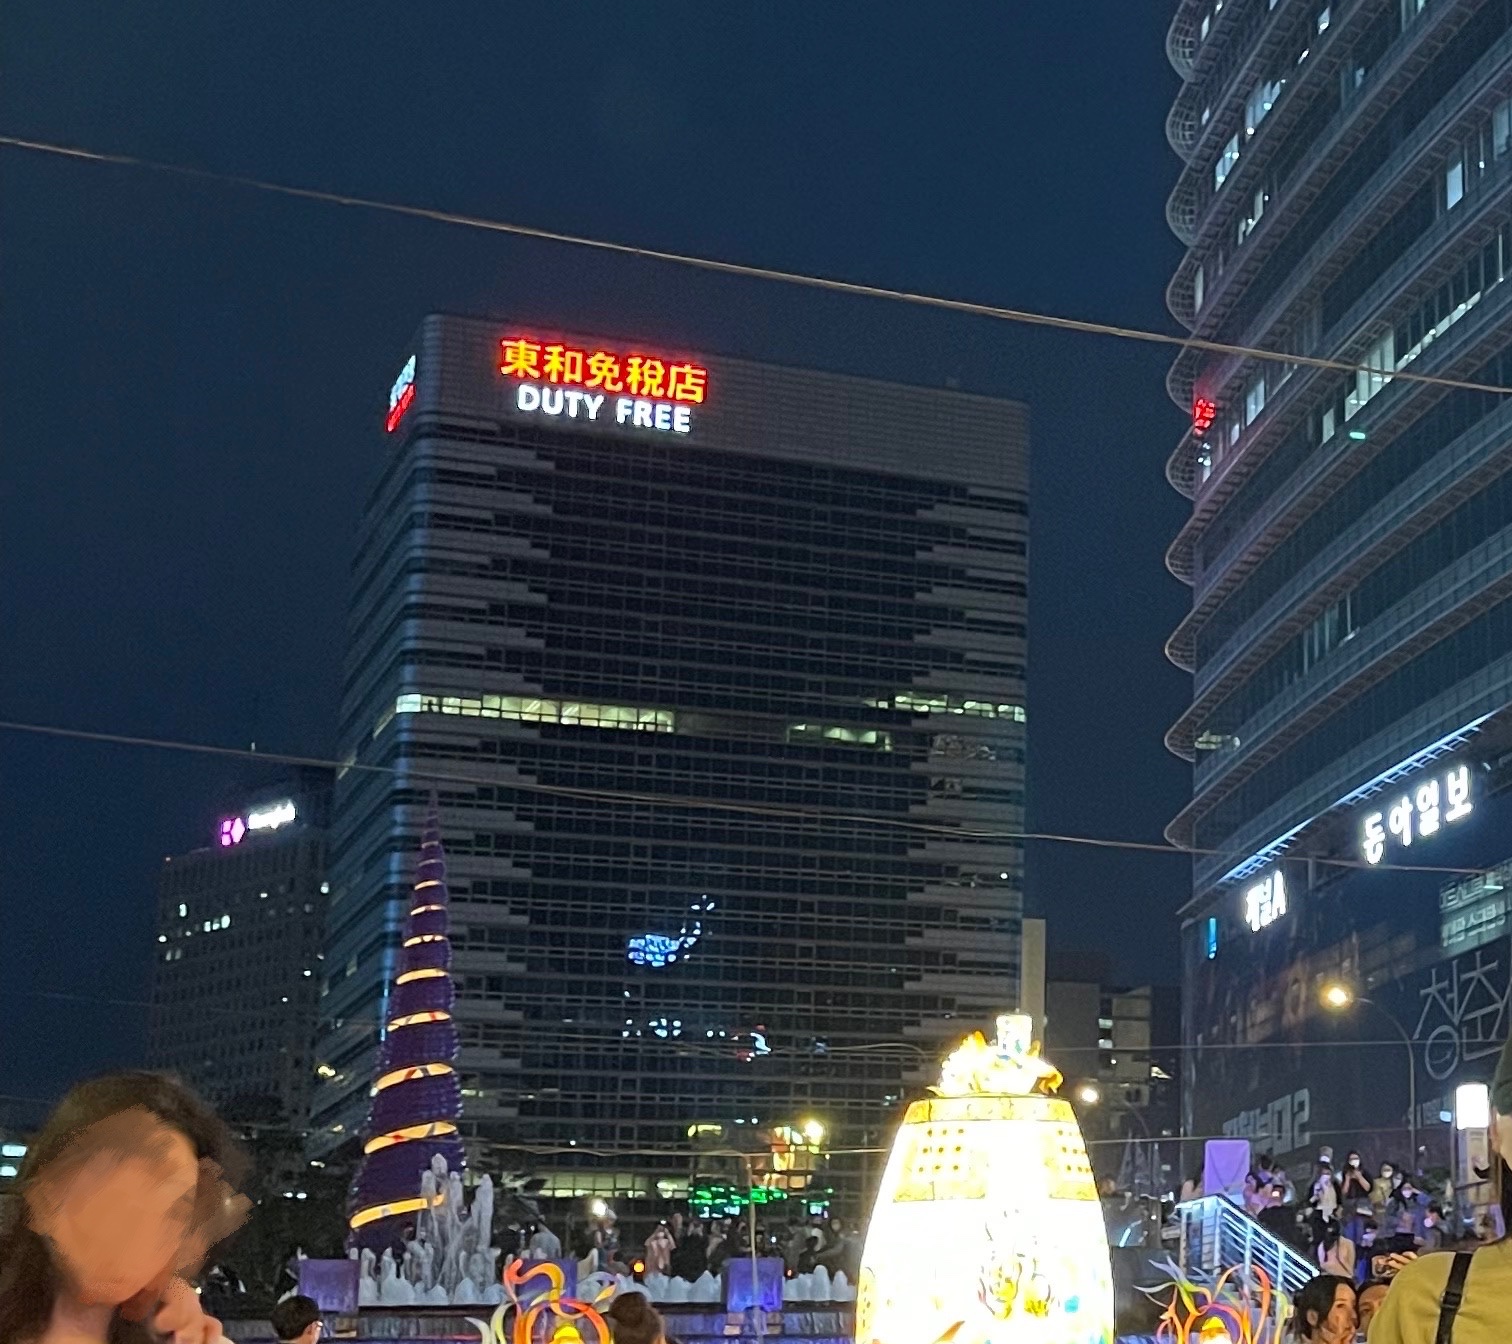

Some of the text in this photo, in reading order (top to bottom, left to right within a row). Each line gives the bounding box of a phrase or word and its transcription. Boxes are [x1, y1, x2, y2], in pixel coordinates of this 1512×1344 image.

[517, 383, 692, 433] DUTY FREE
[1361, 764, 1474, 865] 동아일보
